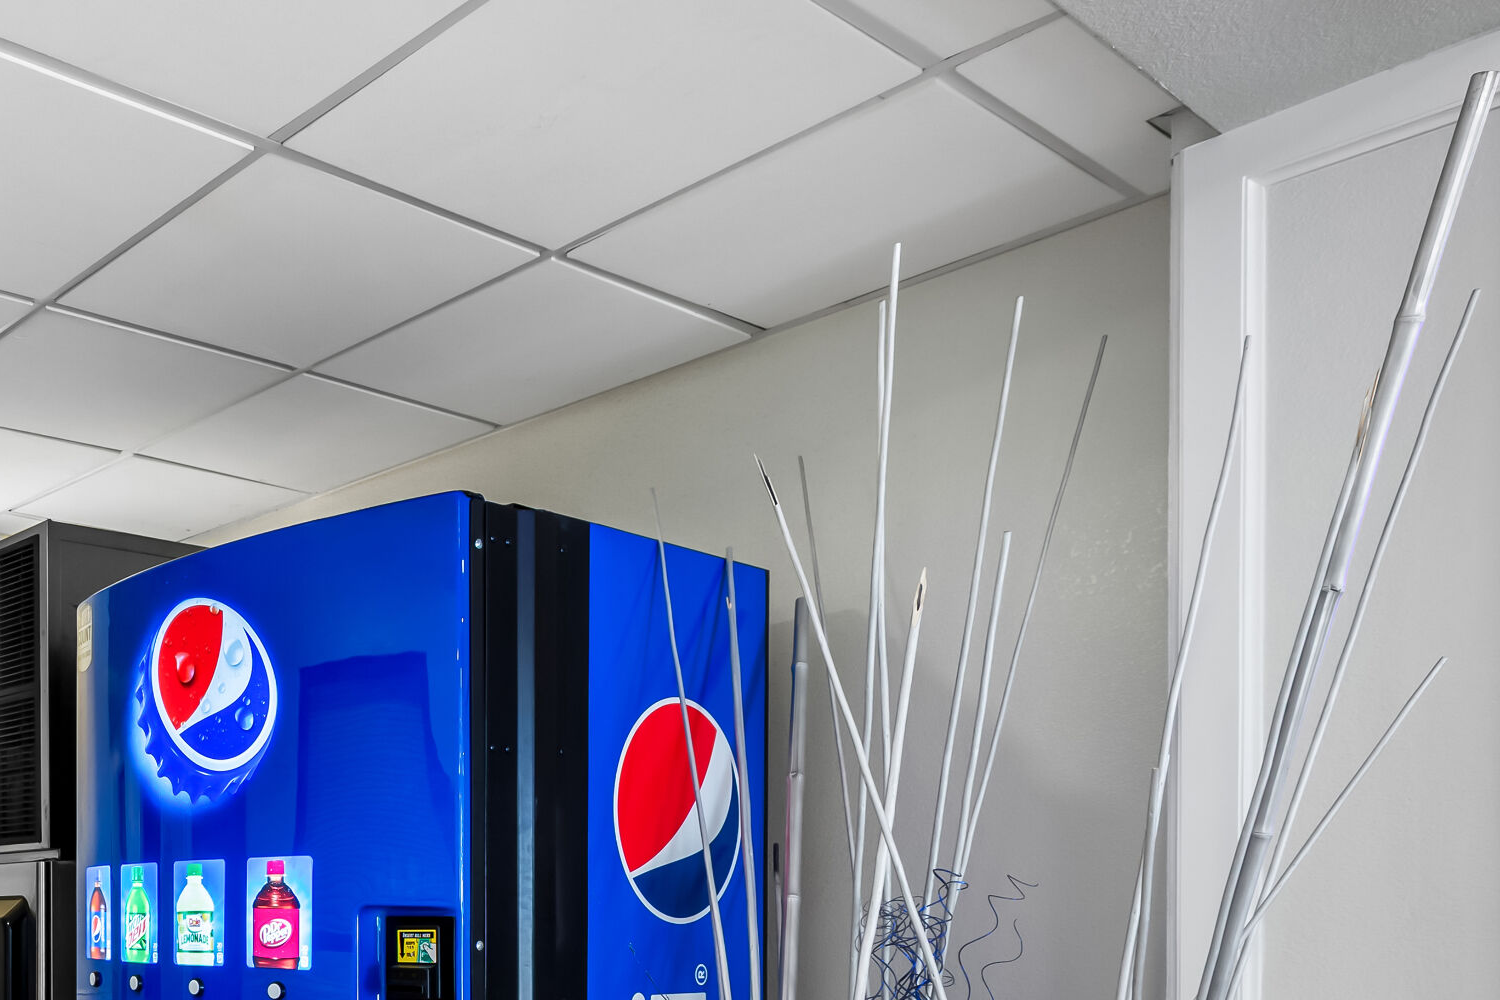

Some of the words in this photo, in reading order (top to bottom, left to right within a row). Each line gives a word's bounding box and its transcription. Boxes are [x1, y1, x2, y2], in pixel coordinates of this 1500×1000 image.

[269, 920, 283, 932] Dr
[181, 933, 209, 946] LEMONADE
[262, 925, 290, 945] Pepper
